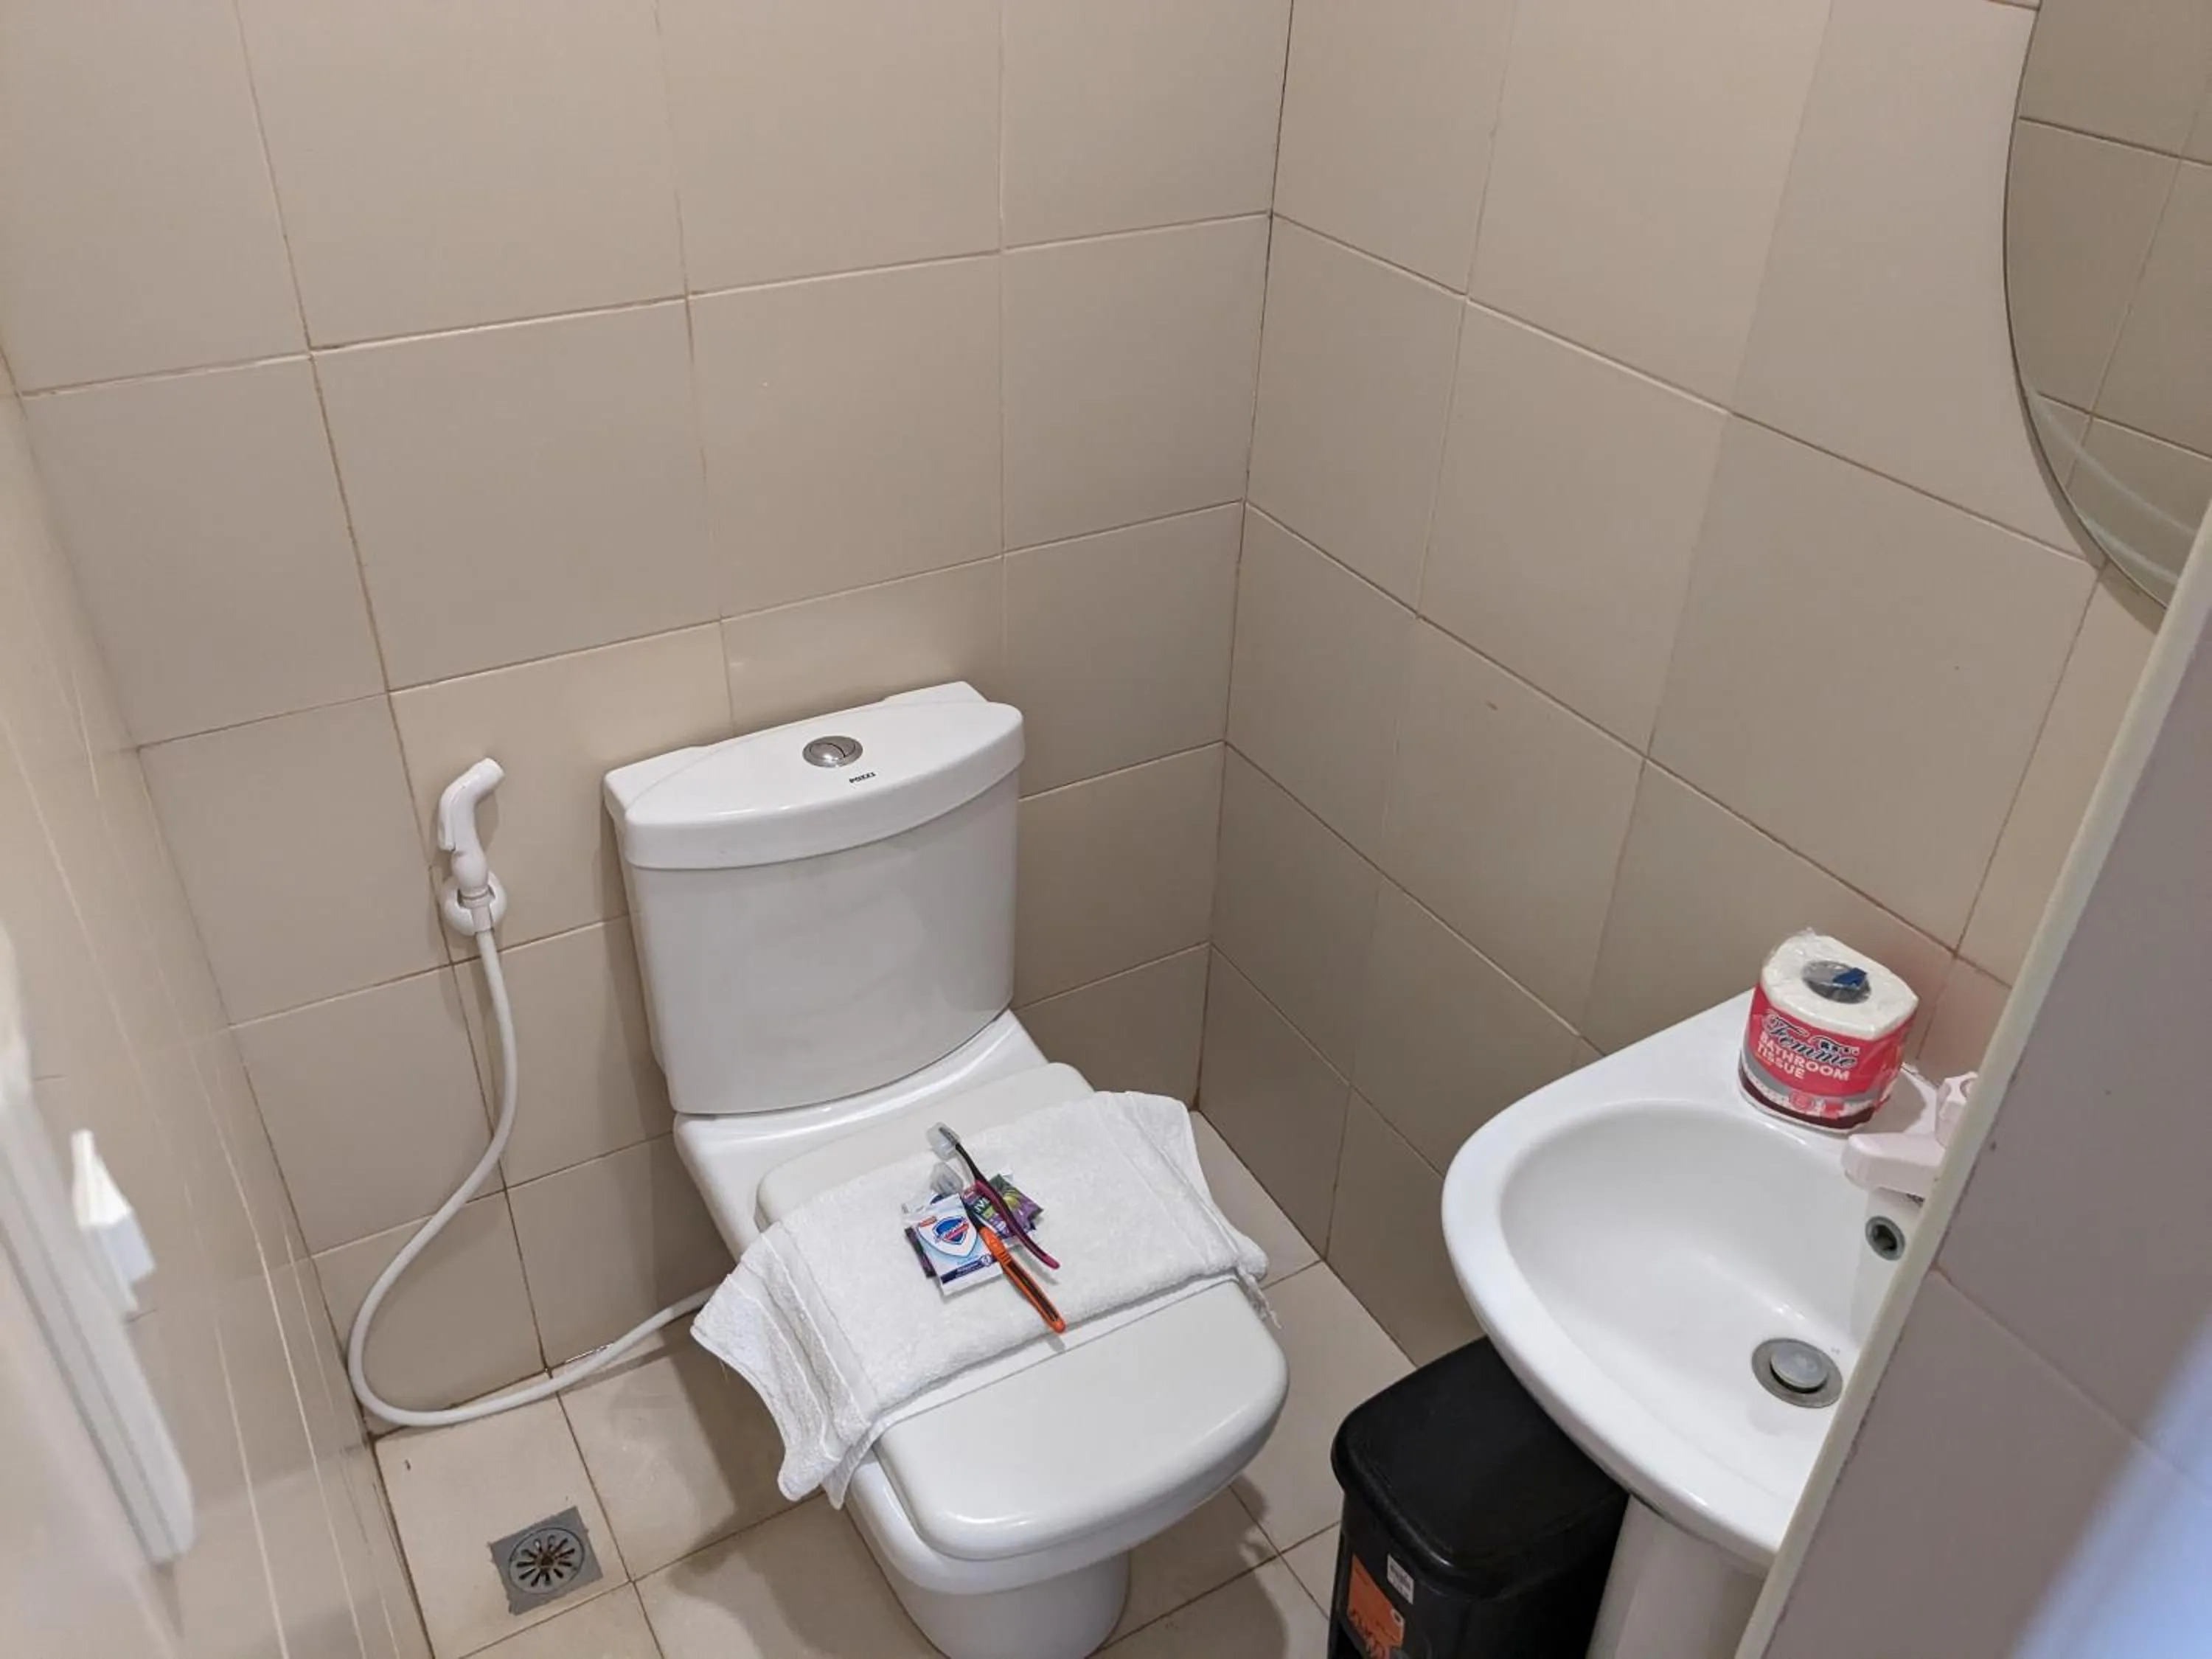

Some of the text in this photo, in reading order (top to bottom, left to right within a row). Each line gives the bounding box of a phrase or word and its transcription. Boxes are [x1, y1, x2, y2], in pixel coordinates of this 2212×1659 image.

[1757, 1044, 1806, 1079] TISSUE
[1760, 1032, 1850, 1081] BATHROOM
[1762, 1011, 1857, 1068] Femme
